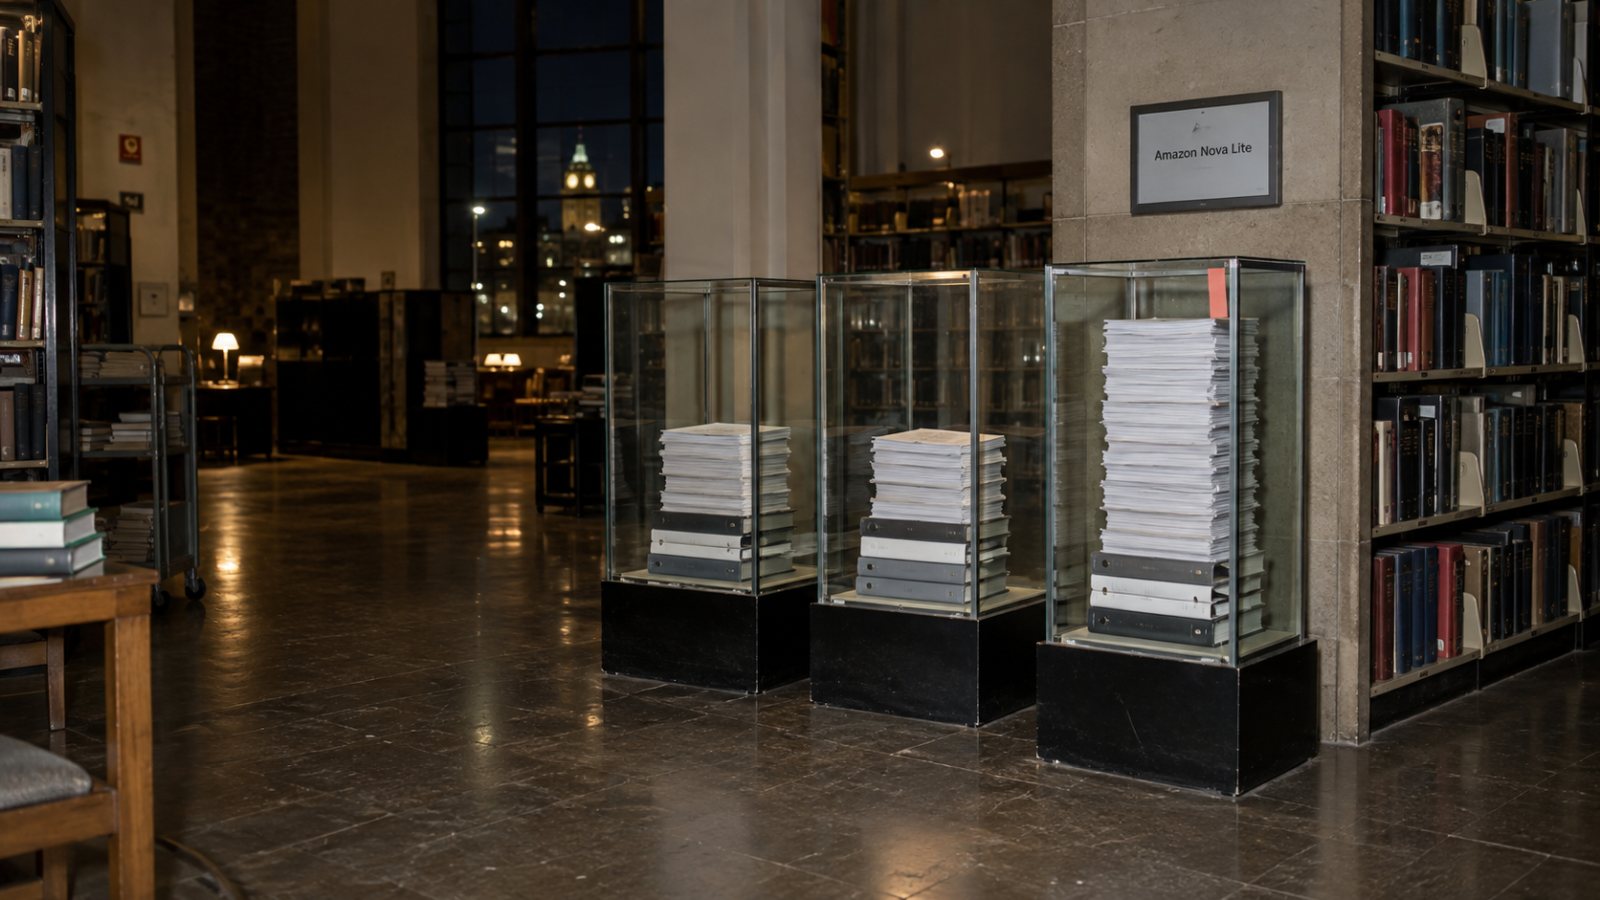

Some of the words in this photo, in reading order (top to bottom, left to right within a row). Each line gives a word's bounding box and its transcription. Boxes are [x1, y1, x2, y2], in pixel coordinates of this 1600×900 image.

[1154, 149, 1197, 161] Amazon
[1200, 145, 1228, 156] Nova
[1231, 142, 1252, 154] Lite
